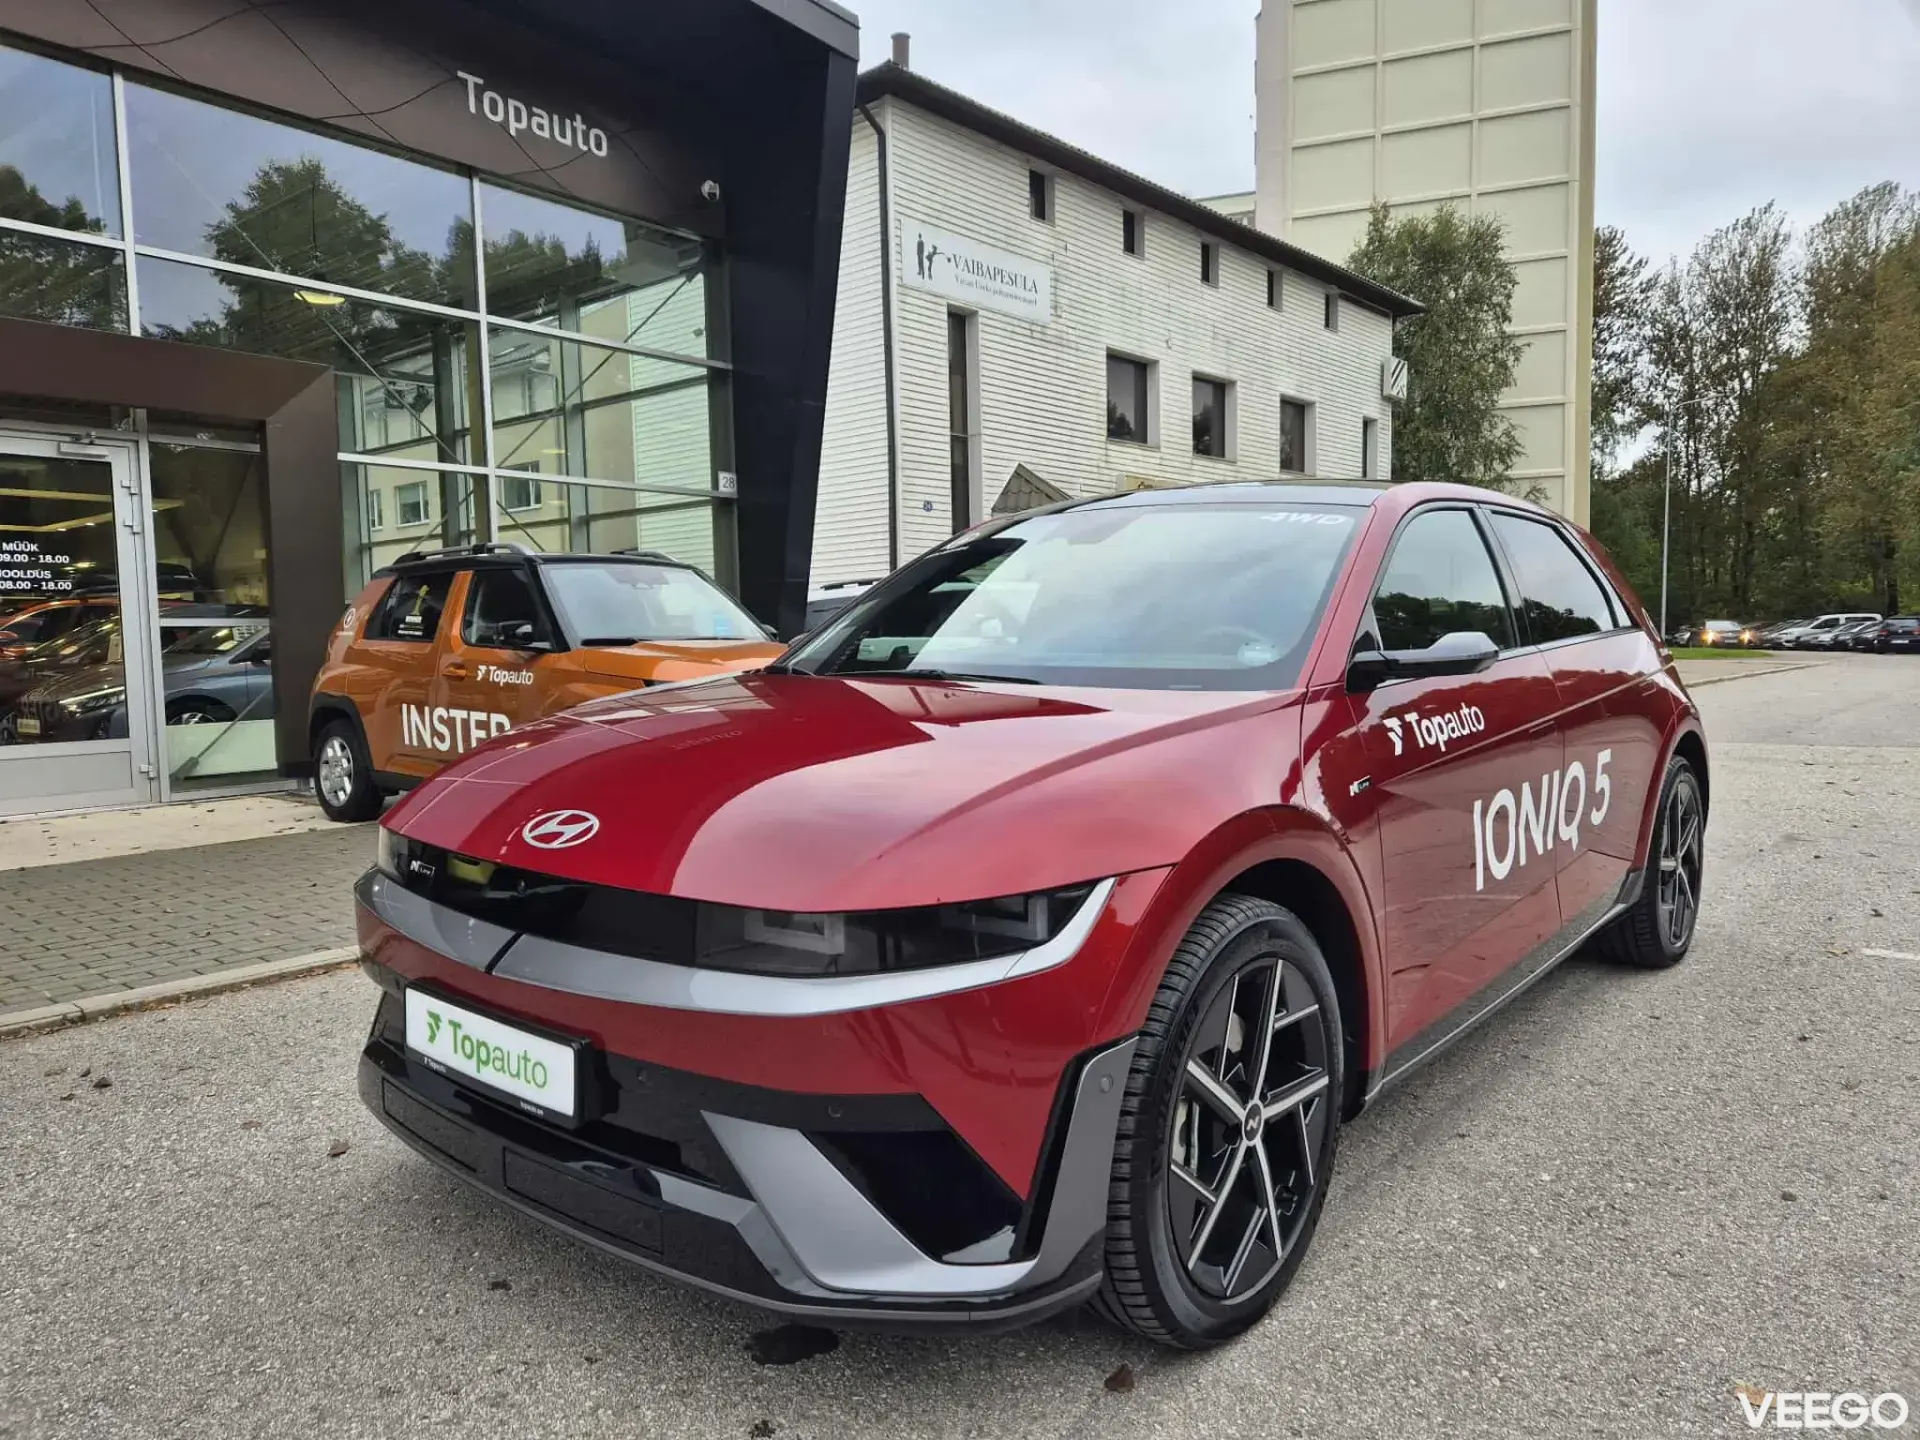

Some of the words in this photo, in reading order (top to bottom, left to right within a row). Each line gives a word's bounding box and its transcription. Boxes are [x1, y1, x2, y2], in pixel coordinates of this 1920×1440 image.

[457, 70, 608, 157] Topauto
[952, 253, 1038, 294] VAIBAPESULA
[722, 476, 736, 489] 28
[1260, 512, 1346, 525] 4WD
[2, 541, 39, 552] MÜÜK
[39, 554, 70, 563] 18.00
[0, 569, 52, 579] OOLDUS
[0, 581, 31, 590] 08.00
[41, 581, 72, 590] 18.00
[488, 665, 534, 687] Topauto
[1405, 702, 1485, 752] Topauto
[1473, 761, 1586, 891] IONIQ
[1591, 748, 1612, 825] 5
[448, 1019, 548, 1089] Topauto
